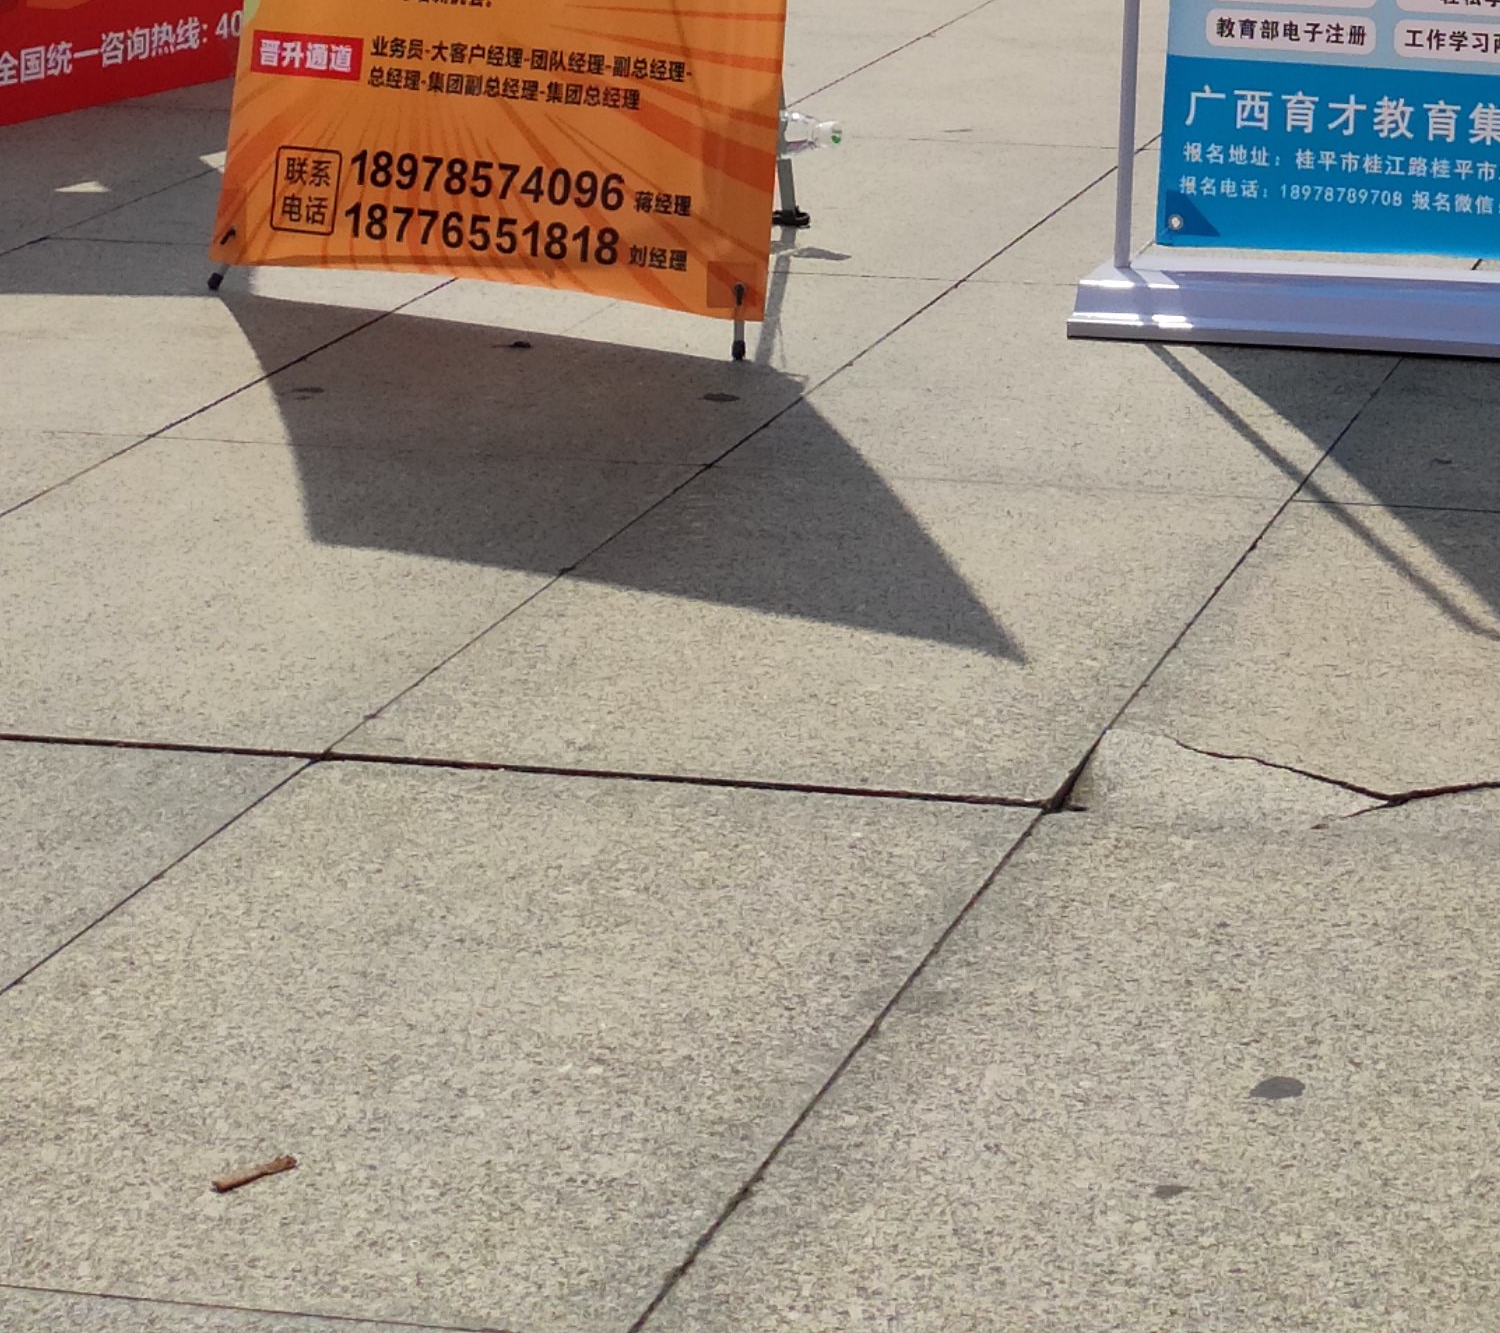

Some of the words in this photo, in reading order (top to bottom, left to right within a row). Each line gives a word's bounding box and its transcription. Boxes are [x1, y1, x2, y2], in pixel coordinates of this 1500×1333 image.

[1215, 17, 1367, 48] 教育部电子注册
[259, 38, 354, 74] 晋升通道
[367, 65, 641, 112] 总经理-集团副总经理-集团总经理
[283, 156, 333, 189] 联系
[350, 147, 626, 212] 18978574096
[633, 189, 692, 218] 蒋经理
[280, 192, 330, 227] 电话
[344, 201, 620, 266] 18776551818
[628, 243, 689, 272] 刘经理
